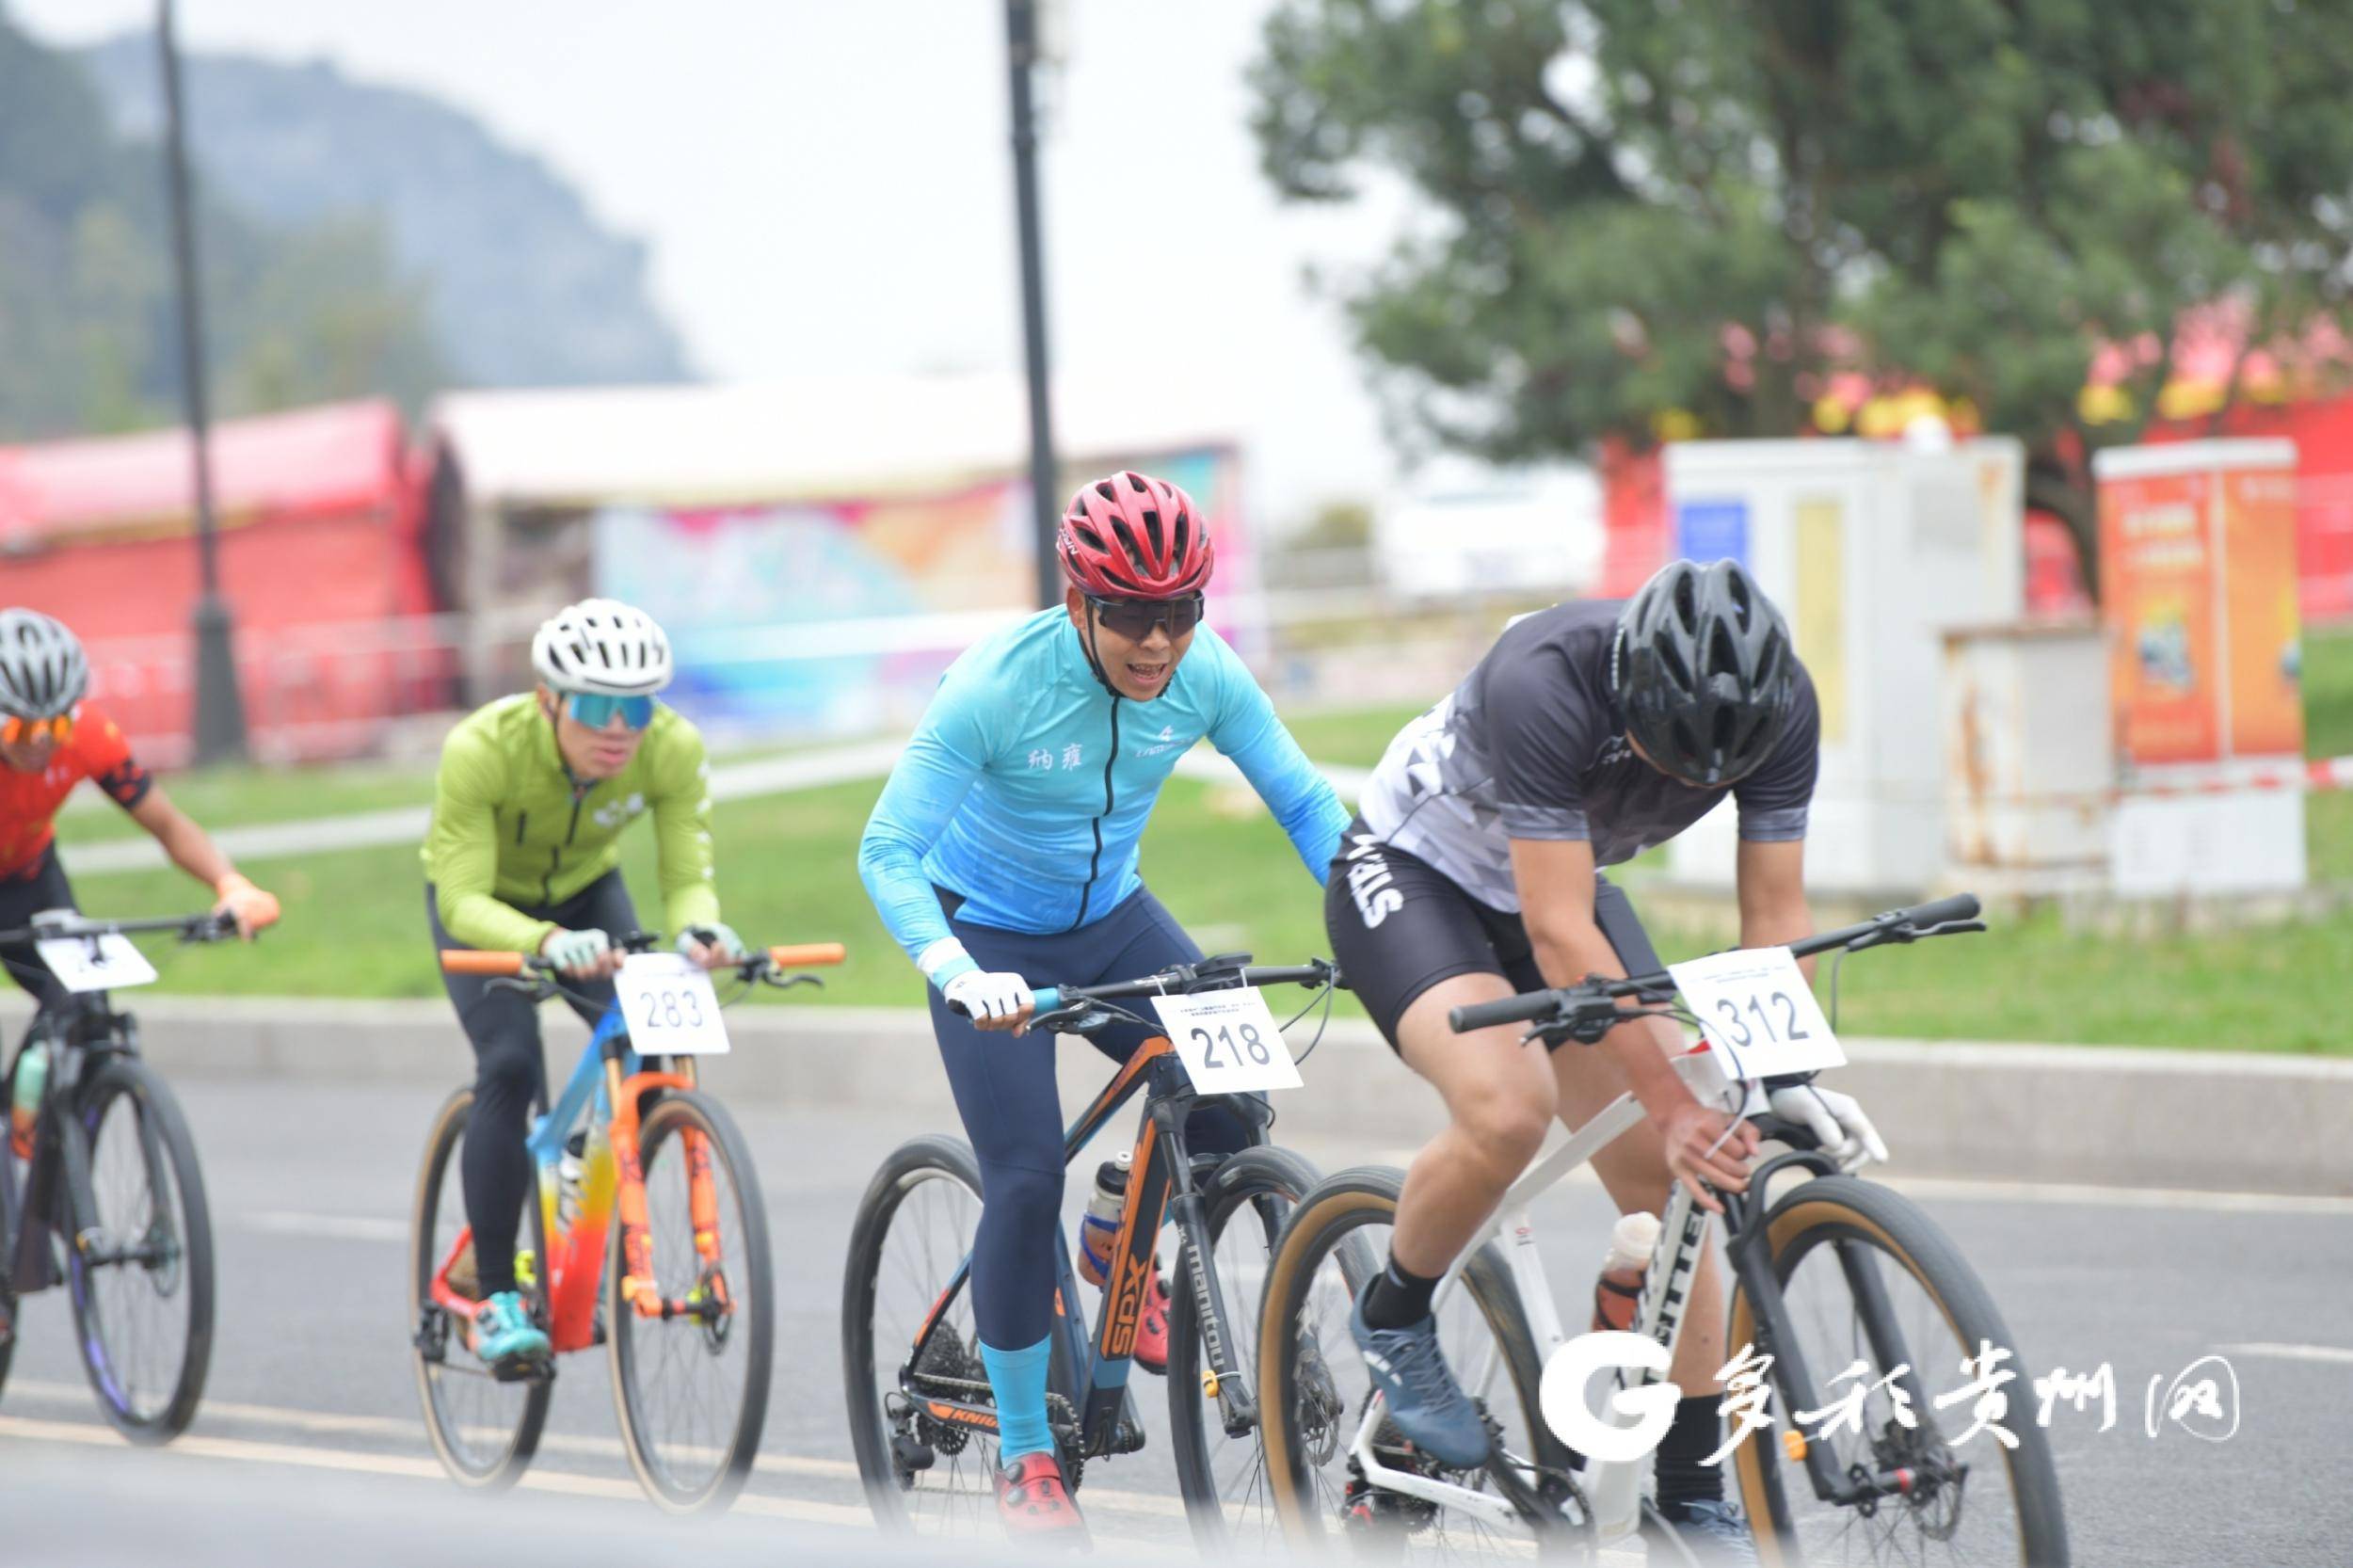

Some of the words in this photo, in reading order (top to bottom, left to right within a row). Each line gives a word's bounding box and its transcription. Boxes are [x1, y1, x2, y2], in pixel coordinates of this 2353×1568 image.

[1027, 743, 1082, 771] 纳雍
[640, 990, 703, 1028] 283
[1717, 991, 1809, 1048] 312
[1191, 1023, 1271, 1069] 218
[1112, 1253, 1148, 1355] SPX
[1188, 1243, 1225, 1368] manitou
